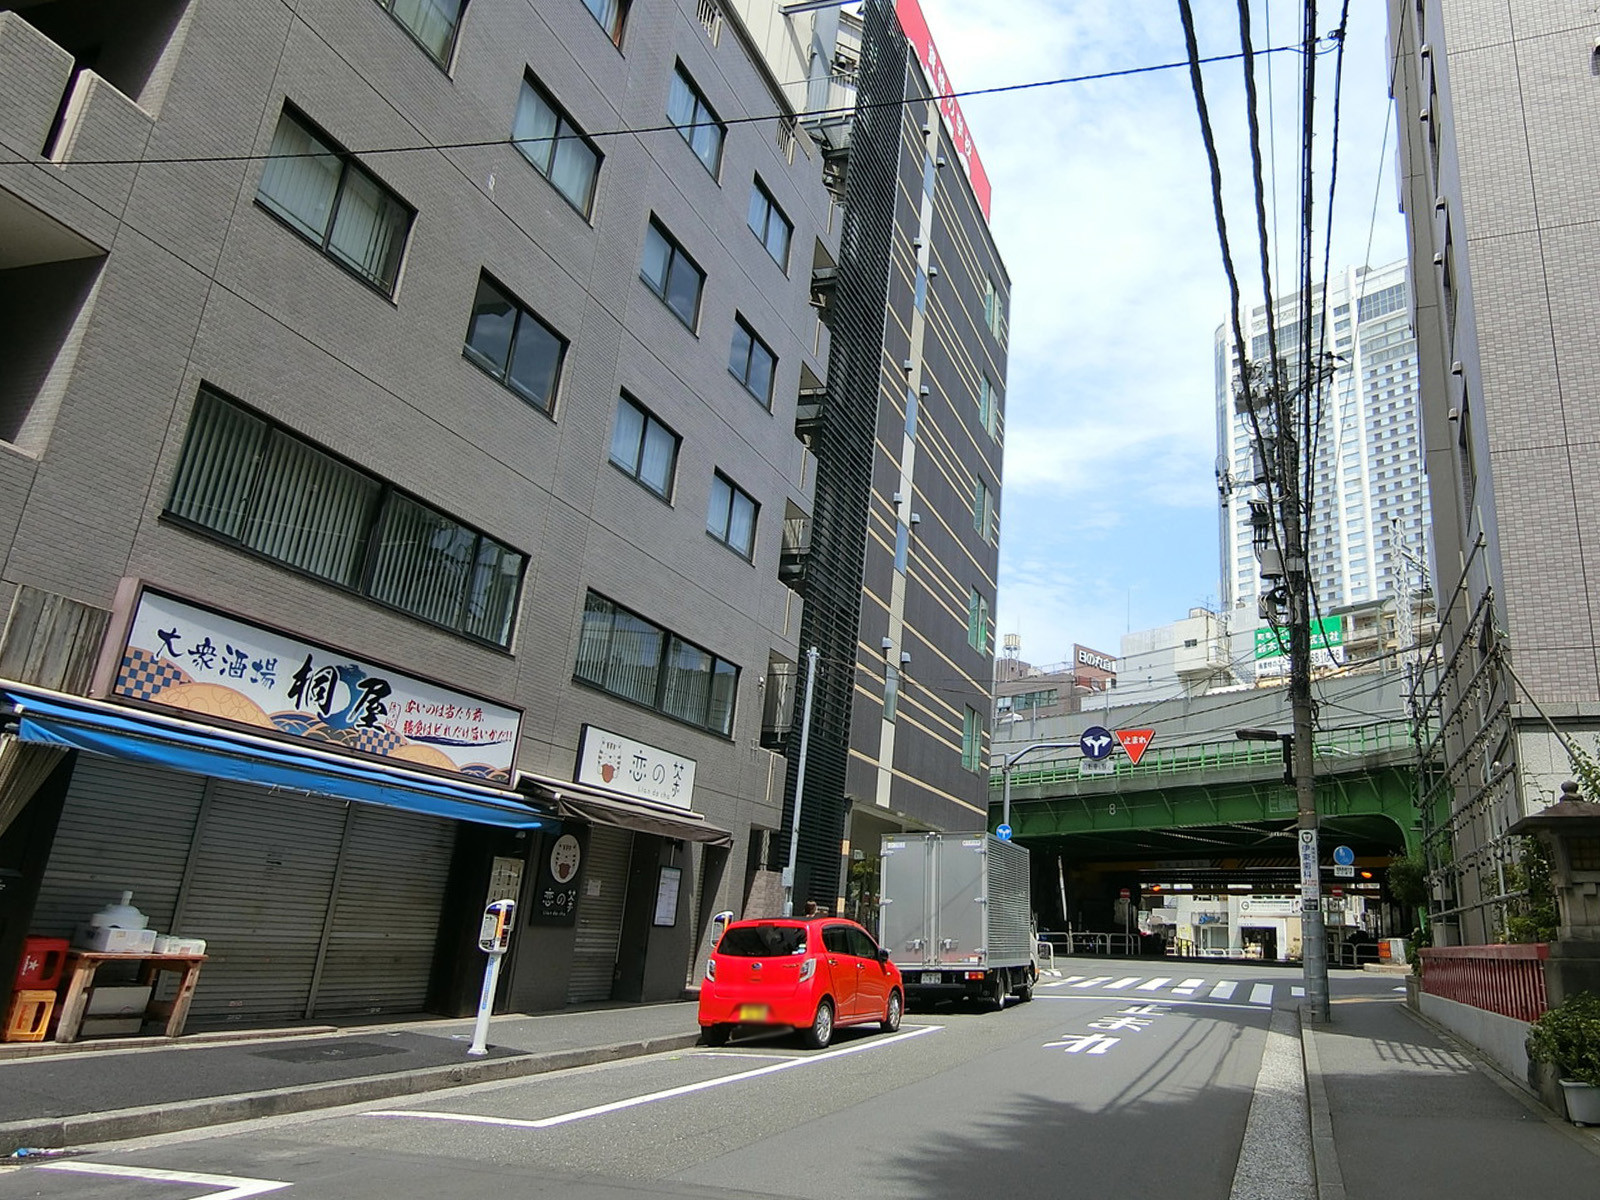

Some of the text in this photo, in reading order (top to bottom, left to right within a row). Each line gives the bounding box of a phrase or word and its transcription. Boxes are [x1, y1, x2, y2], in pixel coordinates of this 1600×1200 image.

[156, 627, 278, 690] 大衆酒場
[287, 653, 392, 734] 桐屋
[1123, 736, 1147, 745] 止まれ
[1108, 803, 1117, 816] 8
